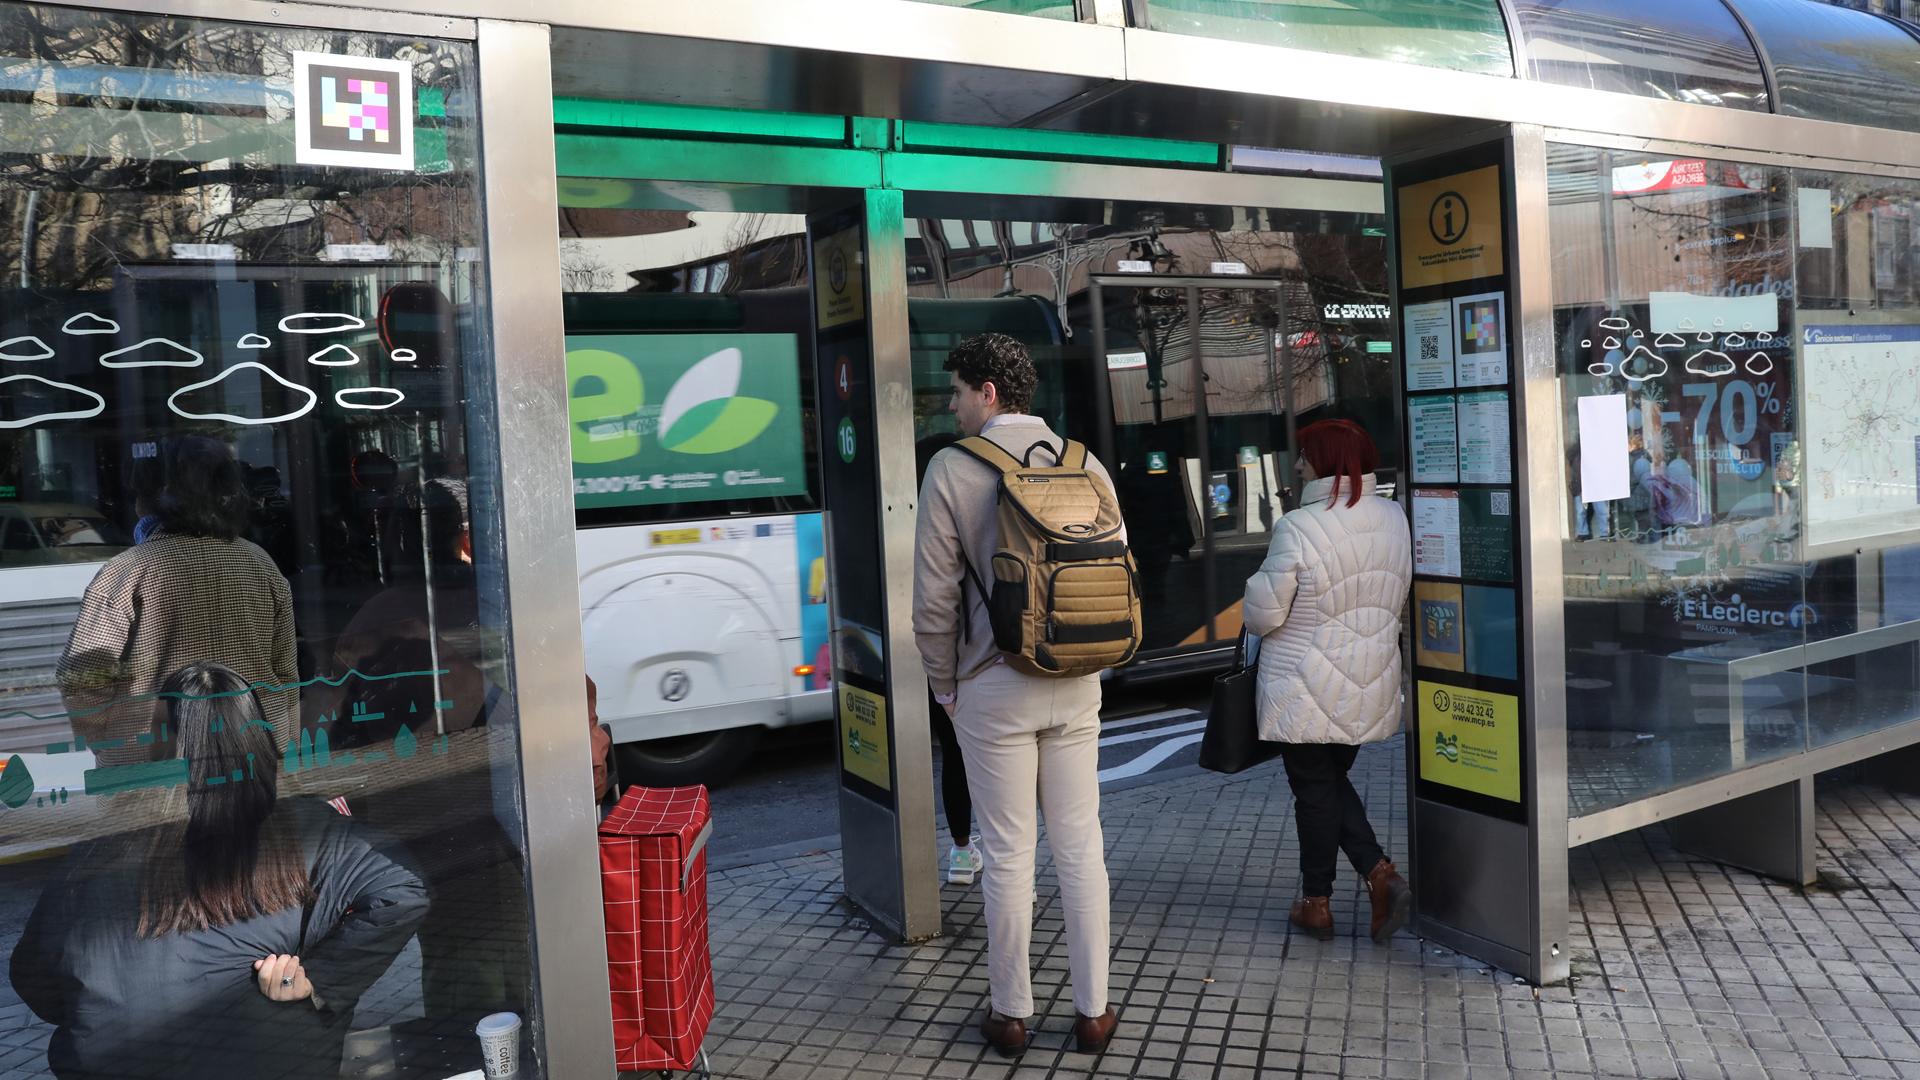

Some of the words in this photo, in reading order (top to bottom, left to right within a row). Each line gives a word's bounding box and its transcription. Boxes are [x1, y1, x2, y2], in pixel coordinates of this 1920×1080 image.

[839, 363, 848, 393] 4
[839, 426, 855, 456] 16
[1695, 622, 1738, 636] PAMPLONA
[1451, 713, 1496, 728] www.mcp.es
[1452, 702, 1465, 713] 948
[1466, 704, 1475, 715] 42
[1475, 706, 1484, 717] 32
[1485, 707, 1495, 719] 42
[499, 1046, 510, 1076] coffee
